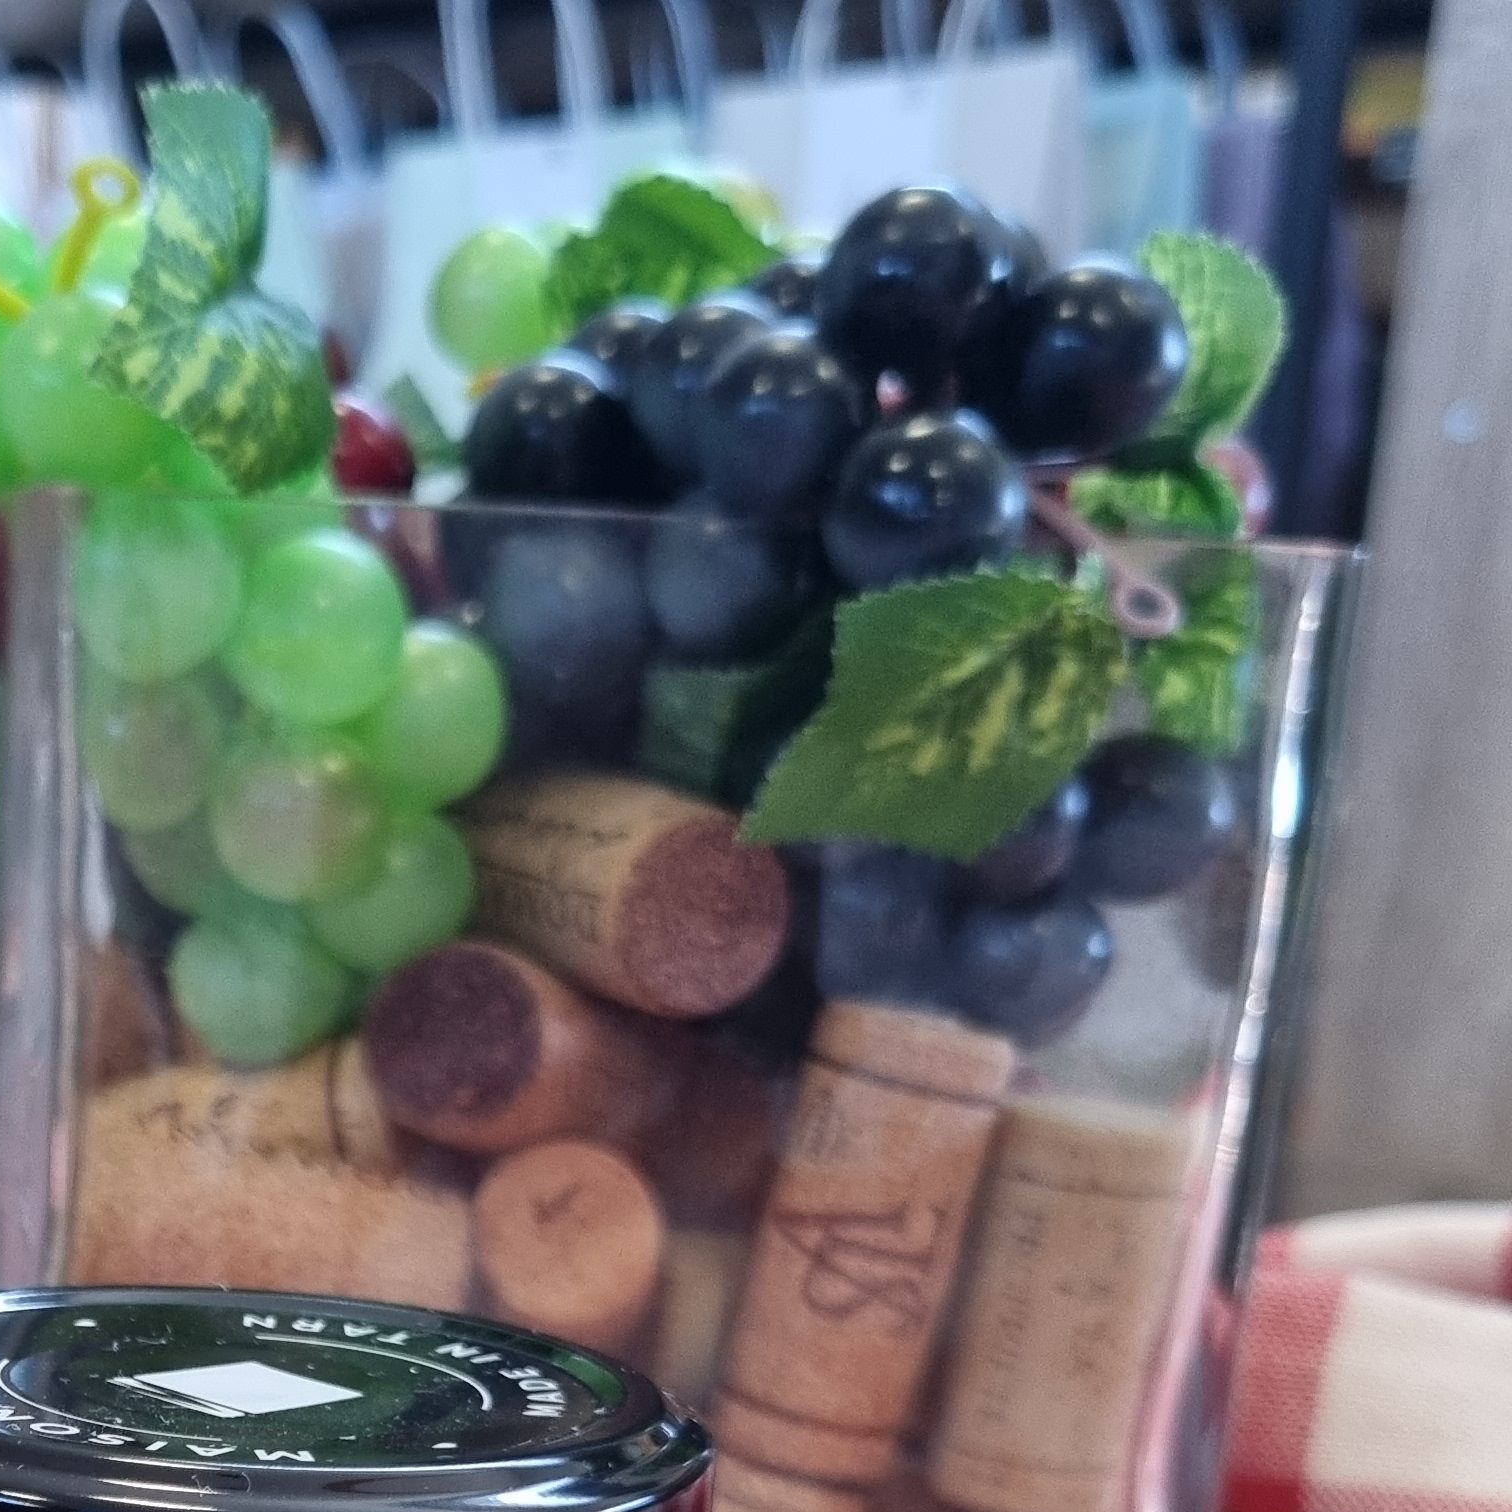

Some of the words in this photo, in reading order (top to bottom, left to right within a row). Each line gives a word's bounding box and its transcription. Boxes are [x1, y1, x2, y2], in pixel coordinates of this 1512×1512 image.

[242, 1313, 414, 1346] TARN
[434, 1341, 504, 1365] IN
[498, 1365, 567, 1418] MADE
